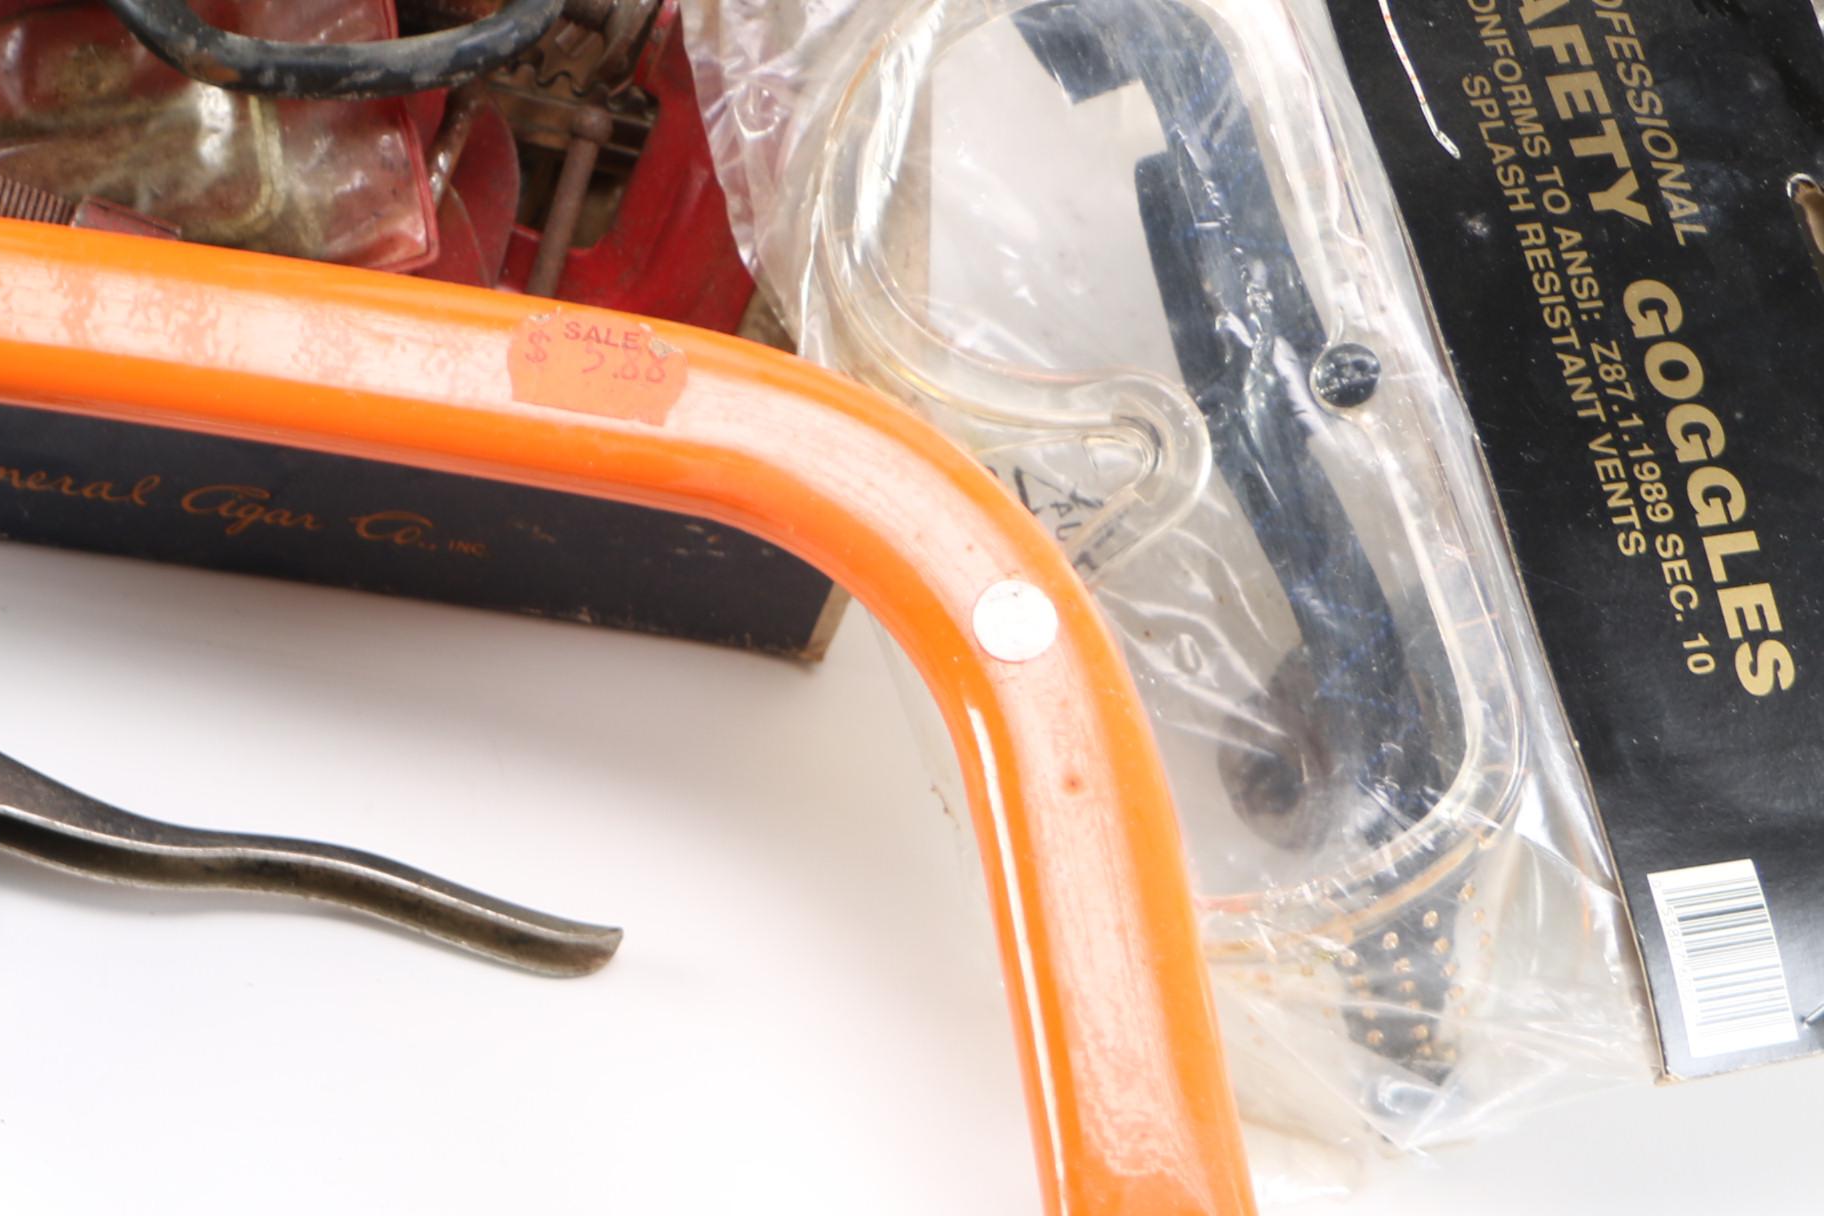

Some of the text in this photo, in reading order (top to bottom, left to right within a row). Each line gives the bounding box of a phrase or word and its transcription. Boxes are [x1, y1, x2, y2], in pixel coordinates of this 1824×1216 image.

[1535, 166, 1572, 215] TO
[1553, 226, 1604, 321] ANSI:
[563, 320, 640, 350] SALE
[1461, 74, 1647, 557] SPLASH RESISTANT VENTS
[180, 483, 325, 536] Cigar
[1622, 278, 1796, 697] GOGGLES
[1654, 532, 1699, 622] SEC.
[1681, 631, 1716, 675] 10
